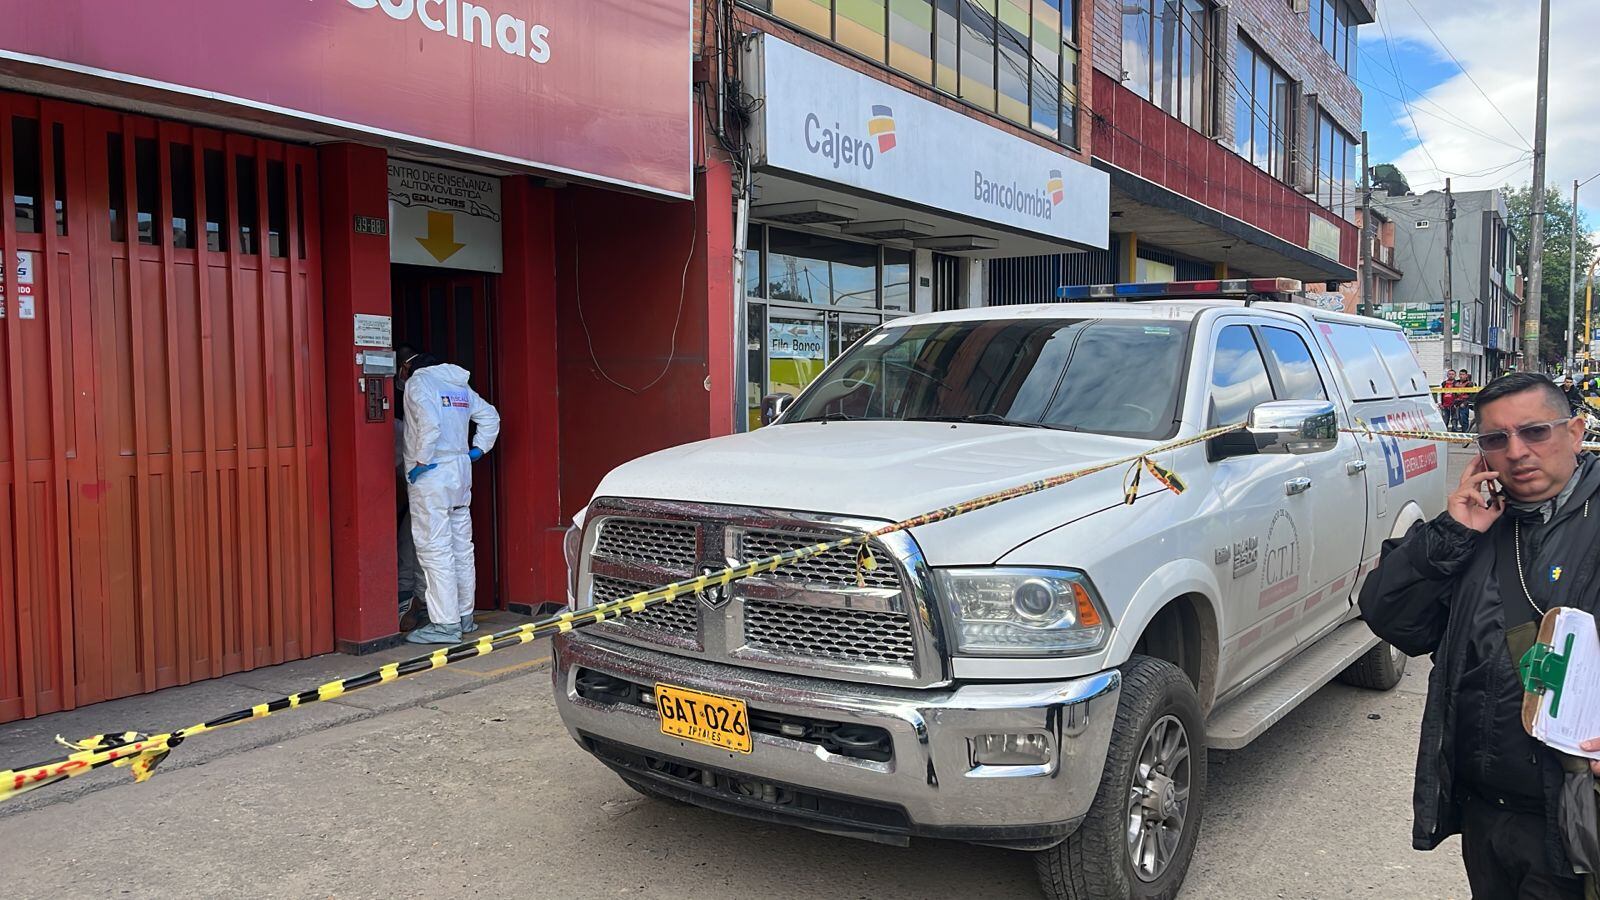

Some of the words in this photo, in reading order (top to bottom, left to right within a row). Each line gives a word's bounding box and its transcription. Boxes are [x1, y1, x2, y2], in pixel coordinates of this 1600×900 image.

[346, 0, 551, 64] ocinas
[804, 112, 874, 170] Cajero
[388, 165, 420, 180] ENTRO
[422, 170, 435, 183] DE
[437, 173, 493, 193] ENSEÑANZA
[974, 170, 1052, 221] Bancolombia
[1385, 311, 1407, 320] MC
[792, 339, 821, 352] Banco
[659, 694, 698, 725] GAT
[703, 703, 745, 736] 026
